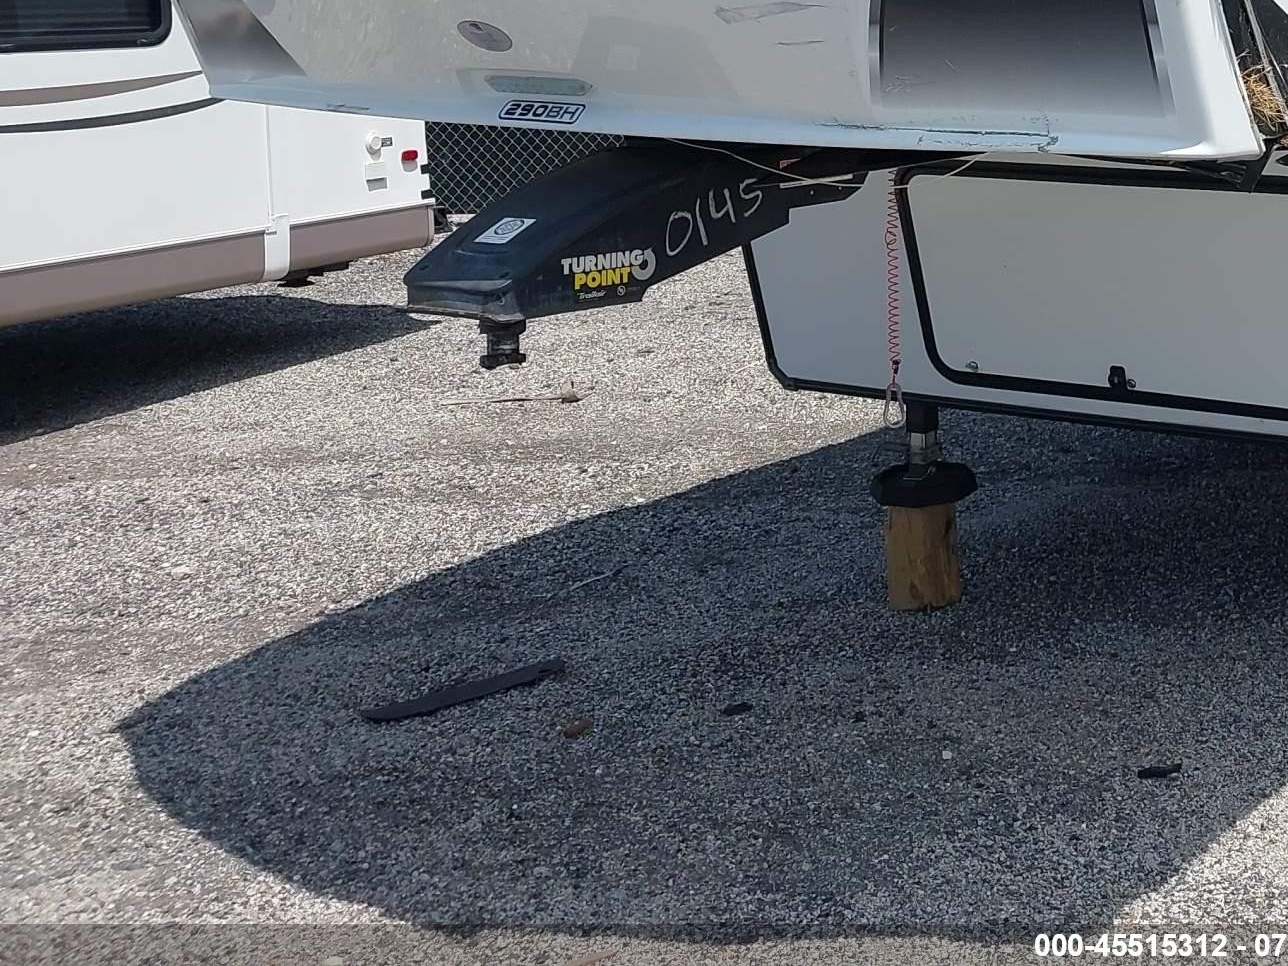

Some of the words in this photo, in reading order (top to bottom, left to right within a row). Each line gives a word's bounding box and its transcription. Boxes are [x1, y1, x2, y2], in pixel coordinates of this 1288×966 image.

[503, 102, 580, 121] 290BH
[665, 177, 763, 257] 0145
[560, 248, 644, 275] TURNING
[574, 266, 631, 291] POINT
